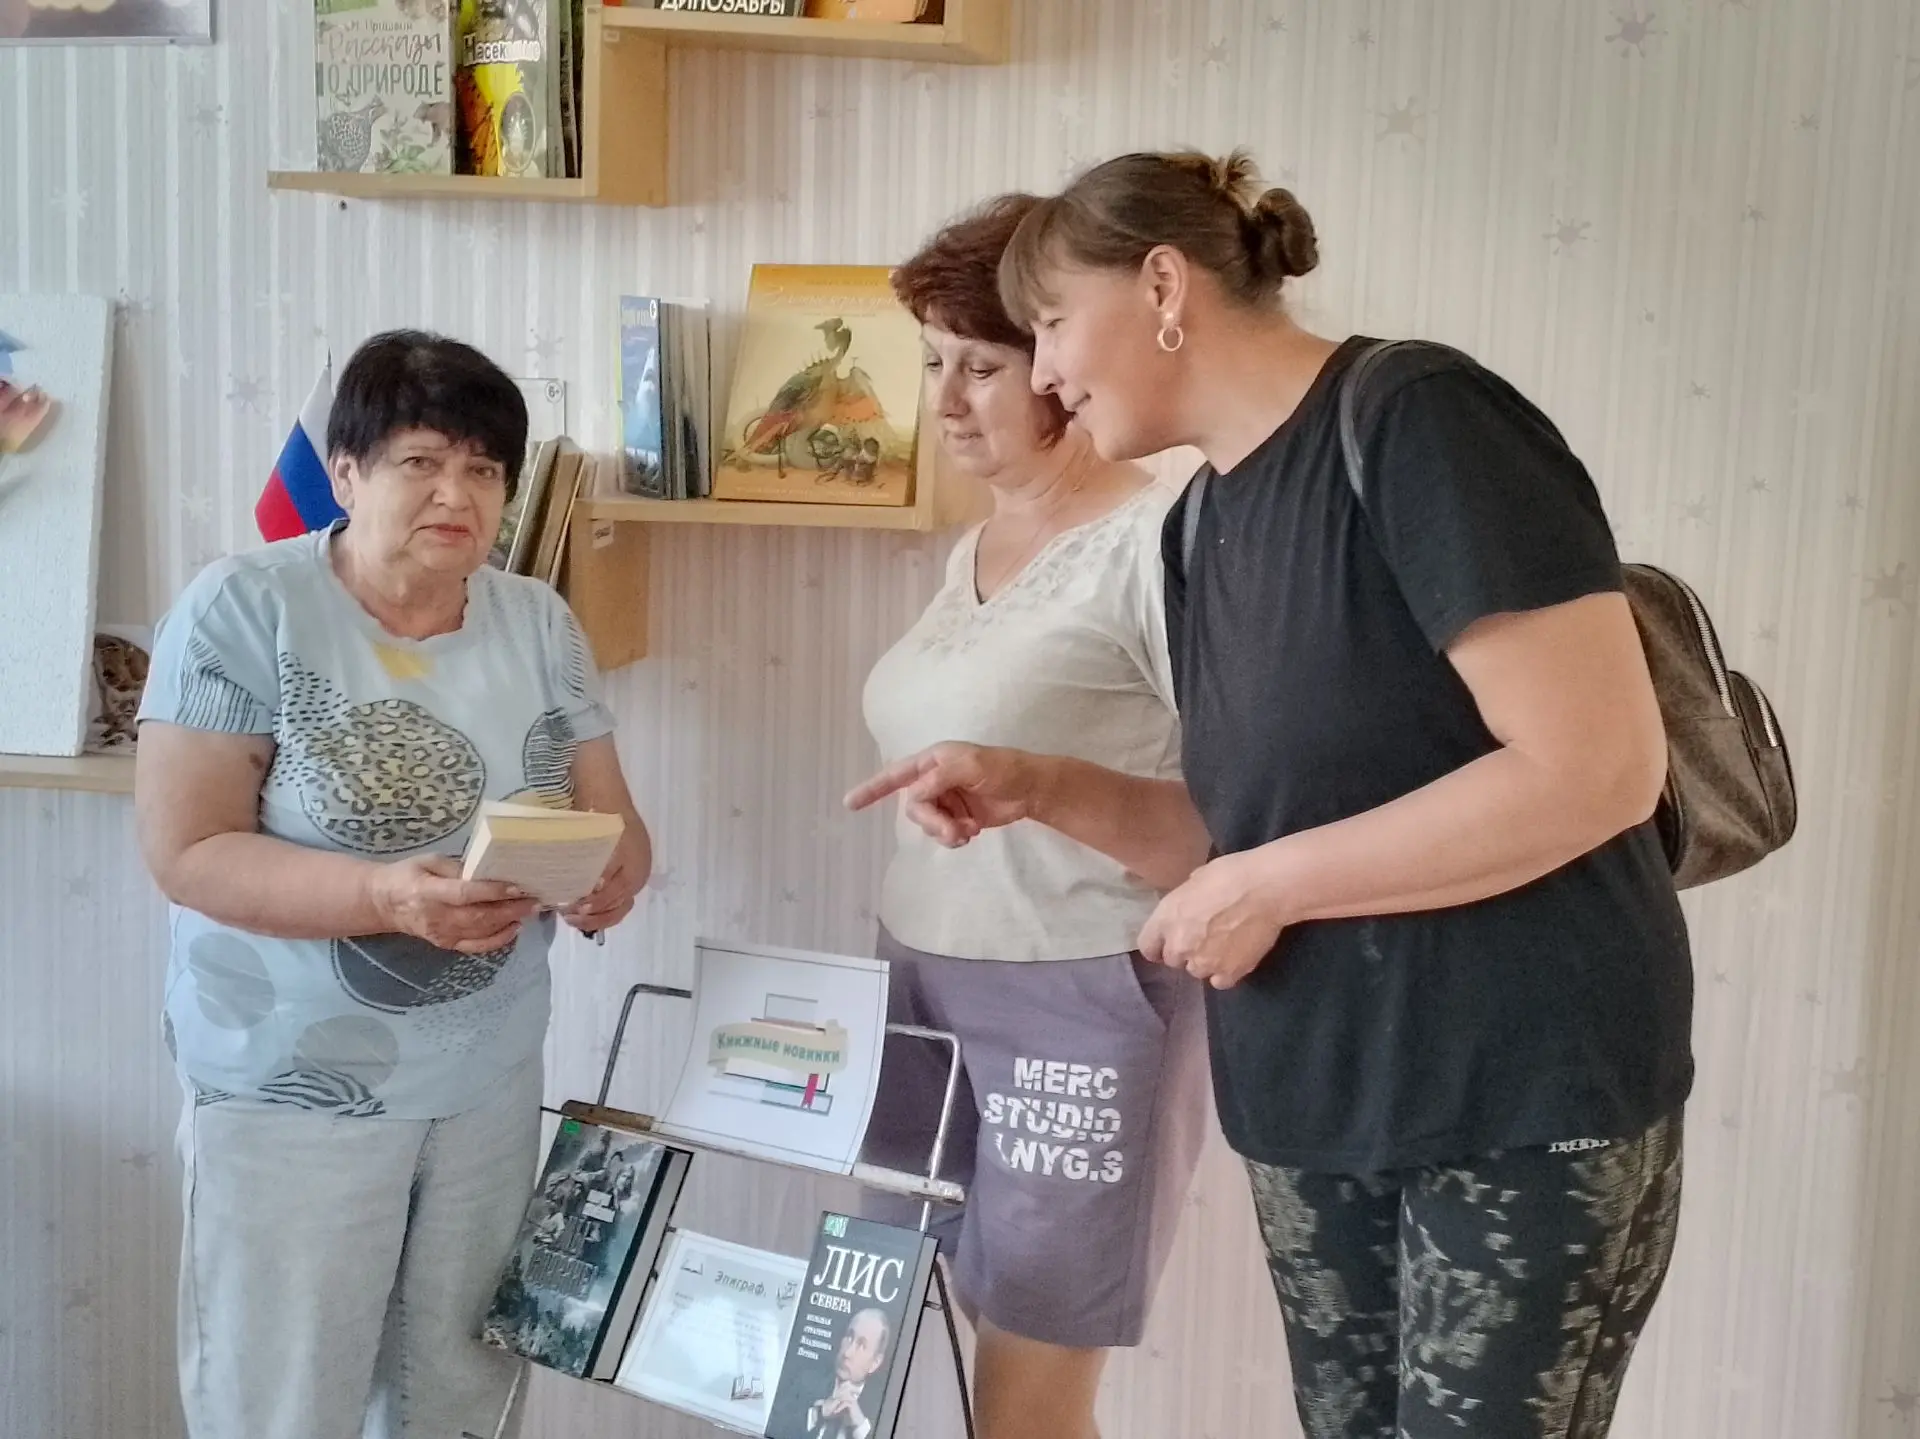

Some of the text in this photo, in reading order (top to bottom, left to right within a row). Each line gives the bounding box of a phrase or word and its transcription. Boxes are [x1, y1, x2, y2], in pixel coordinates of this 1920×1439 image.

[328, 32, 441, 65] Рассказы
[328, 62, 444, 98] О ПРИРОДЕ
[717, 1032, 841, 1064] Книжные новинки
[1014, 1057, 1118, 1100] MERC
[984, 1092, 1122, 1143] STUDIO
[813, 1244, 905, 1303] ЛИС
[810, 1292, 851, 1314] СЕВЕРА
